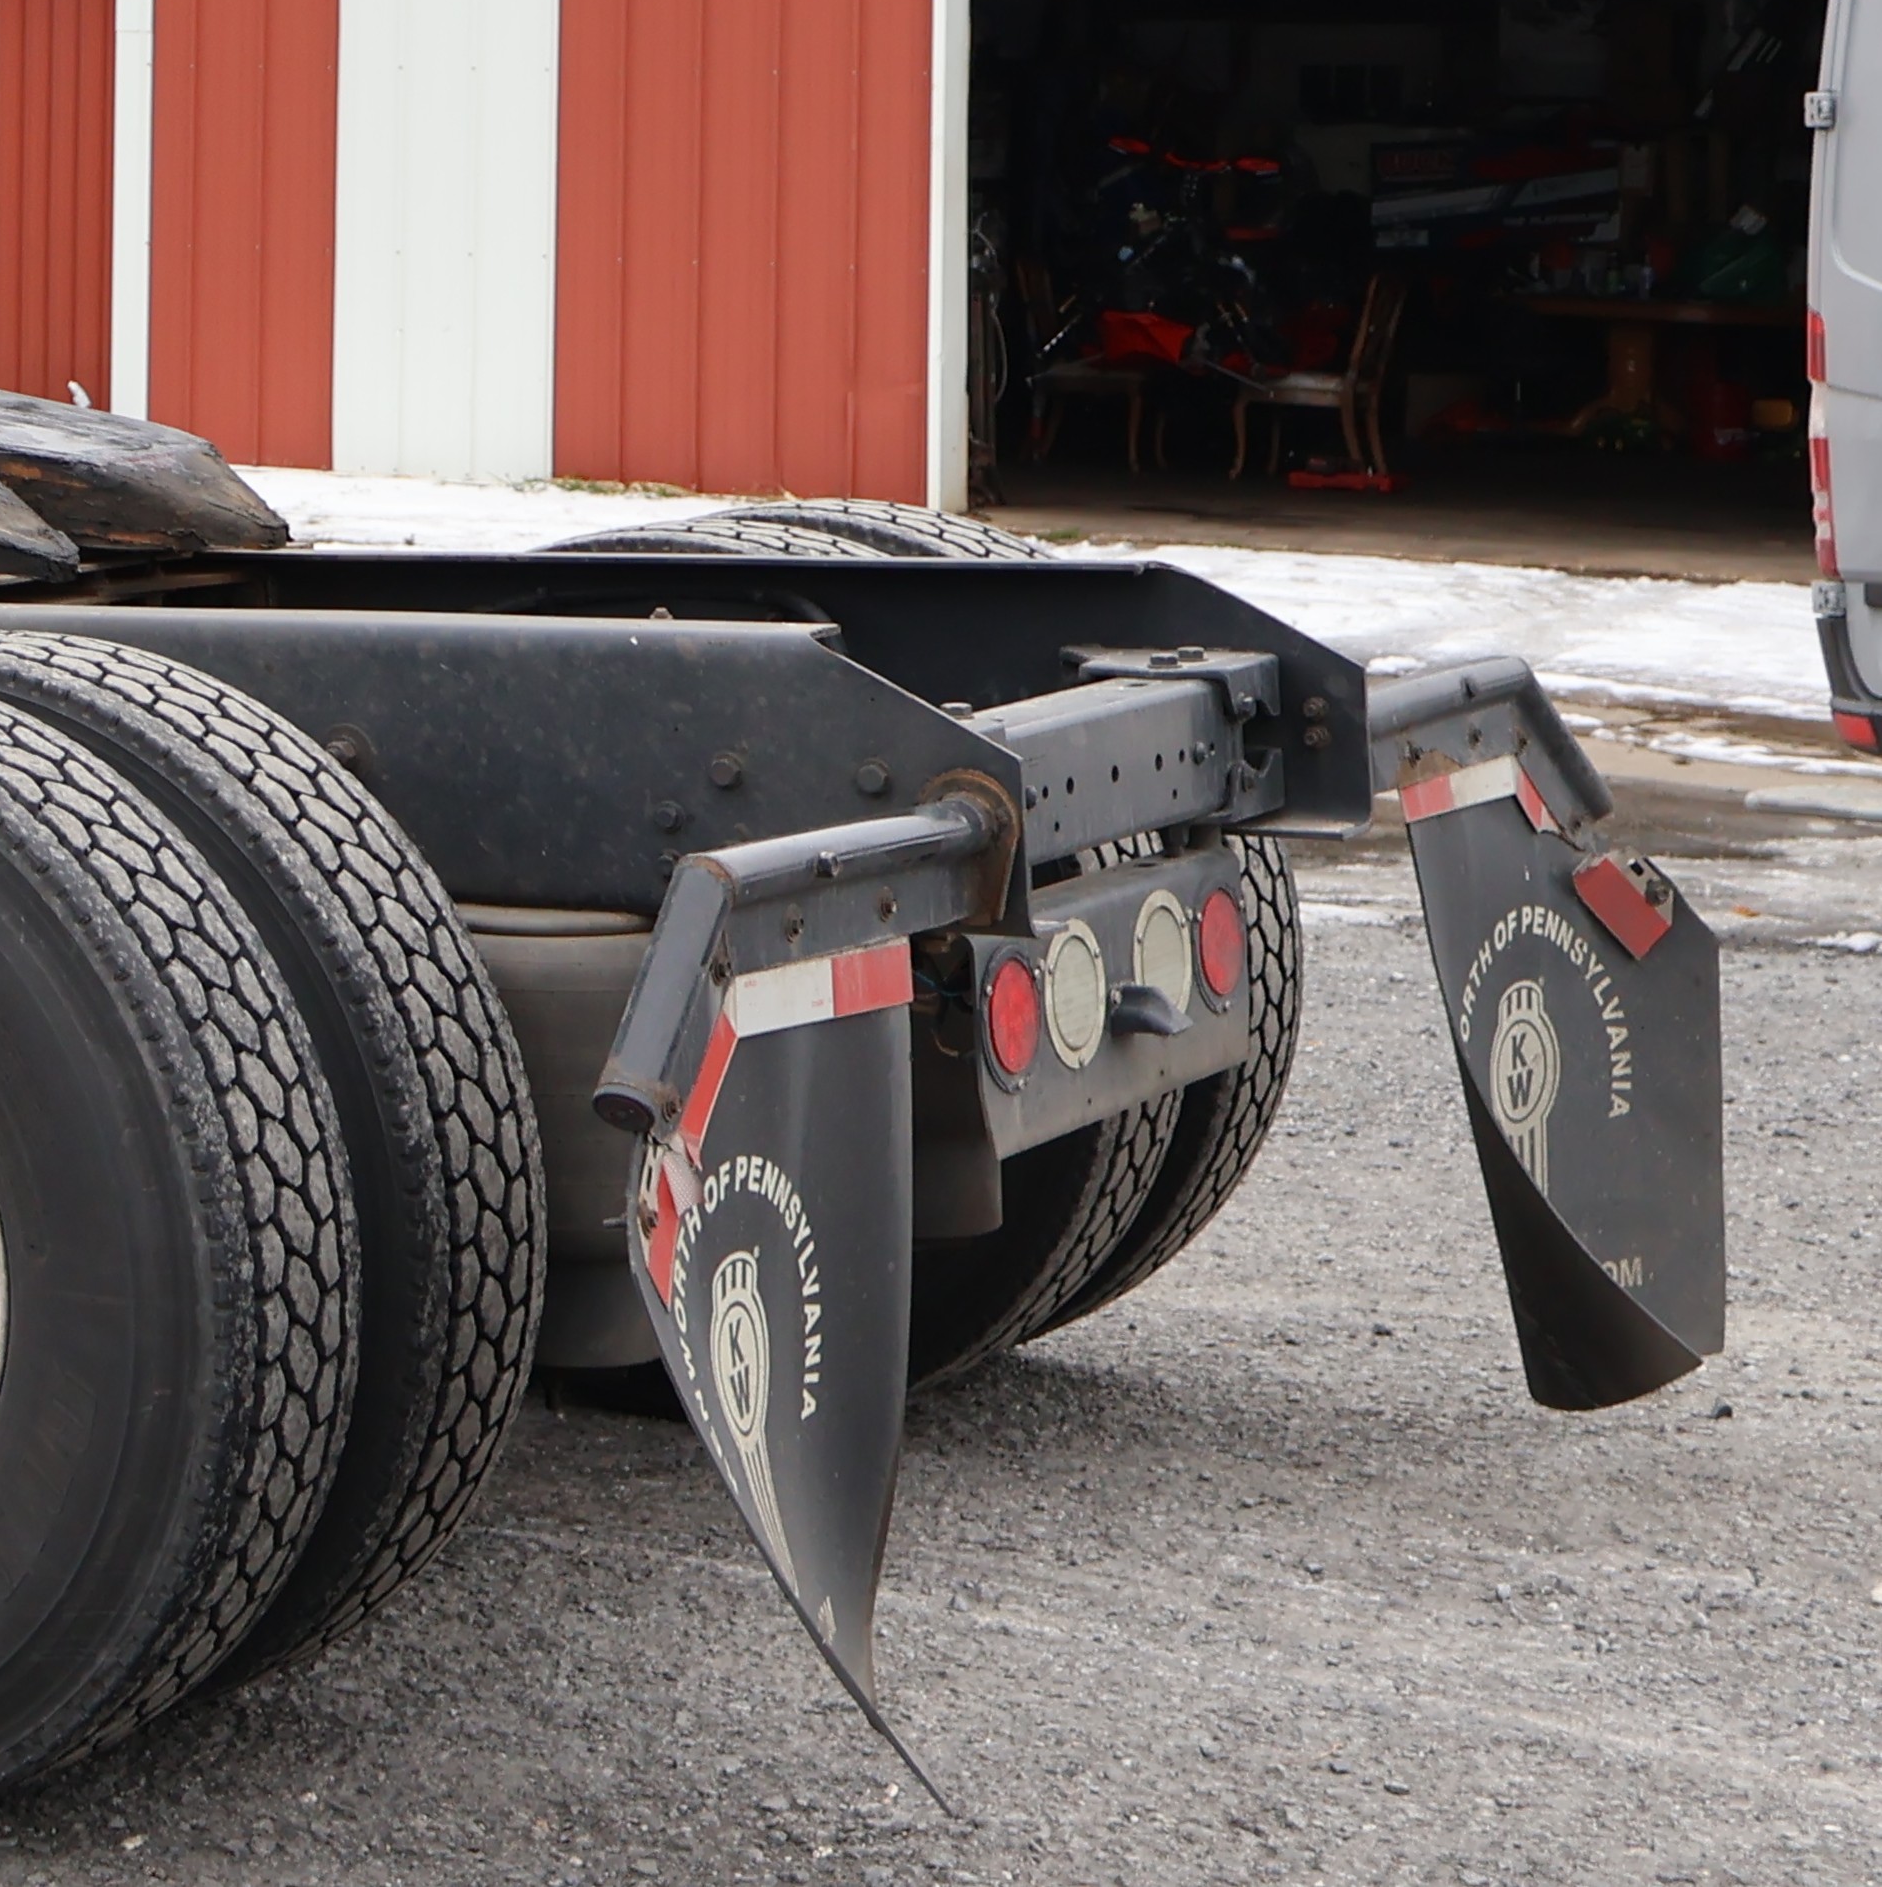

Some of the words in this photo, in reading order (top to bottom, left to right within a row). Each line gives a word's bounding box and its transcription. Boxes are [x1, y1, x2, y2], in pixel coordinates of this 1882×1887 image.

[1494, 909, 1517, 951] OF
[1521, 905, 1633, 1119] PENNSYLVANIA
[703, 1160, 731, 1214] OF
[734, 1155, 822, 1421] PENNSYLVANIA
